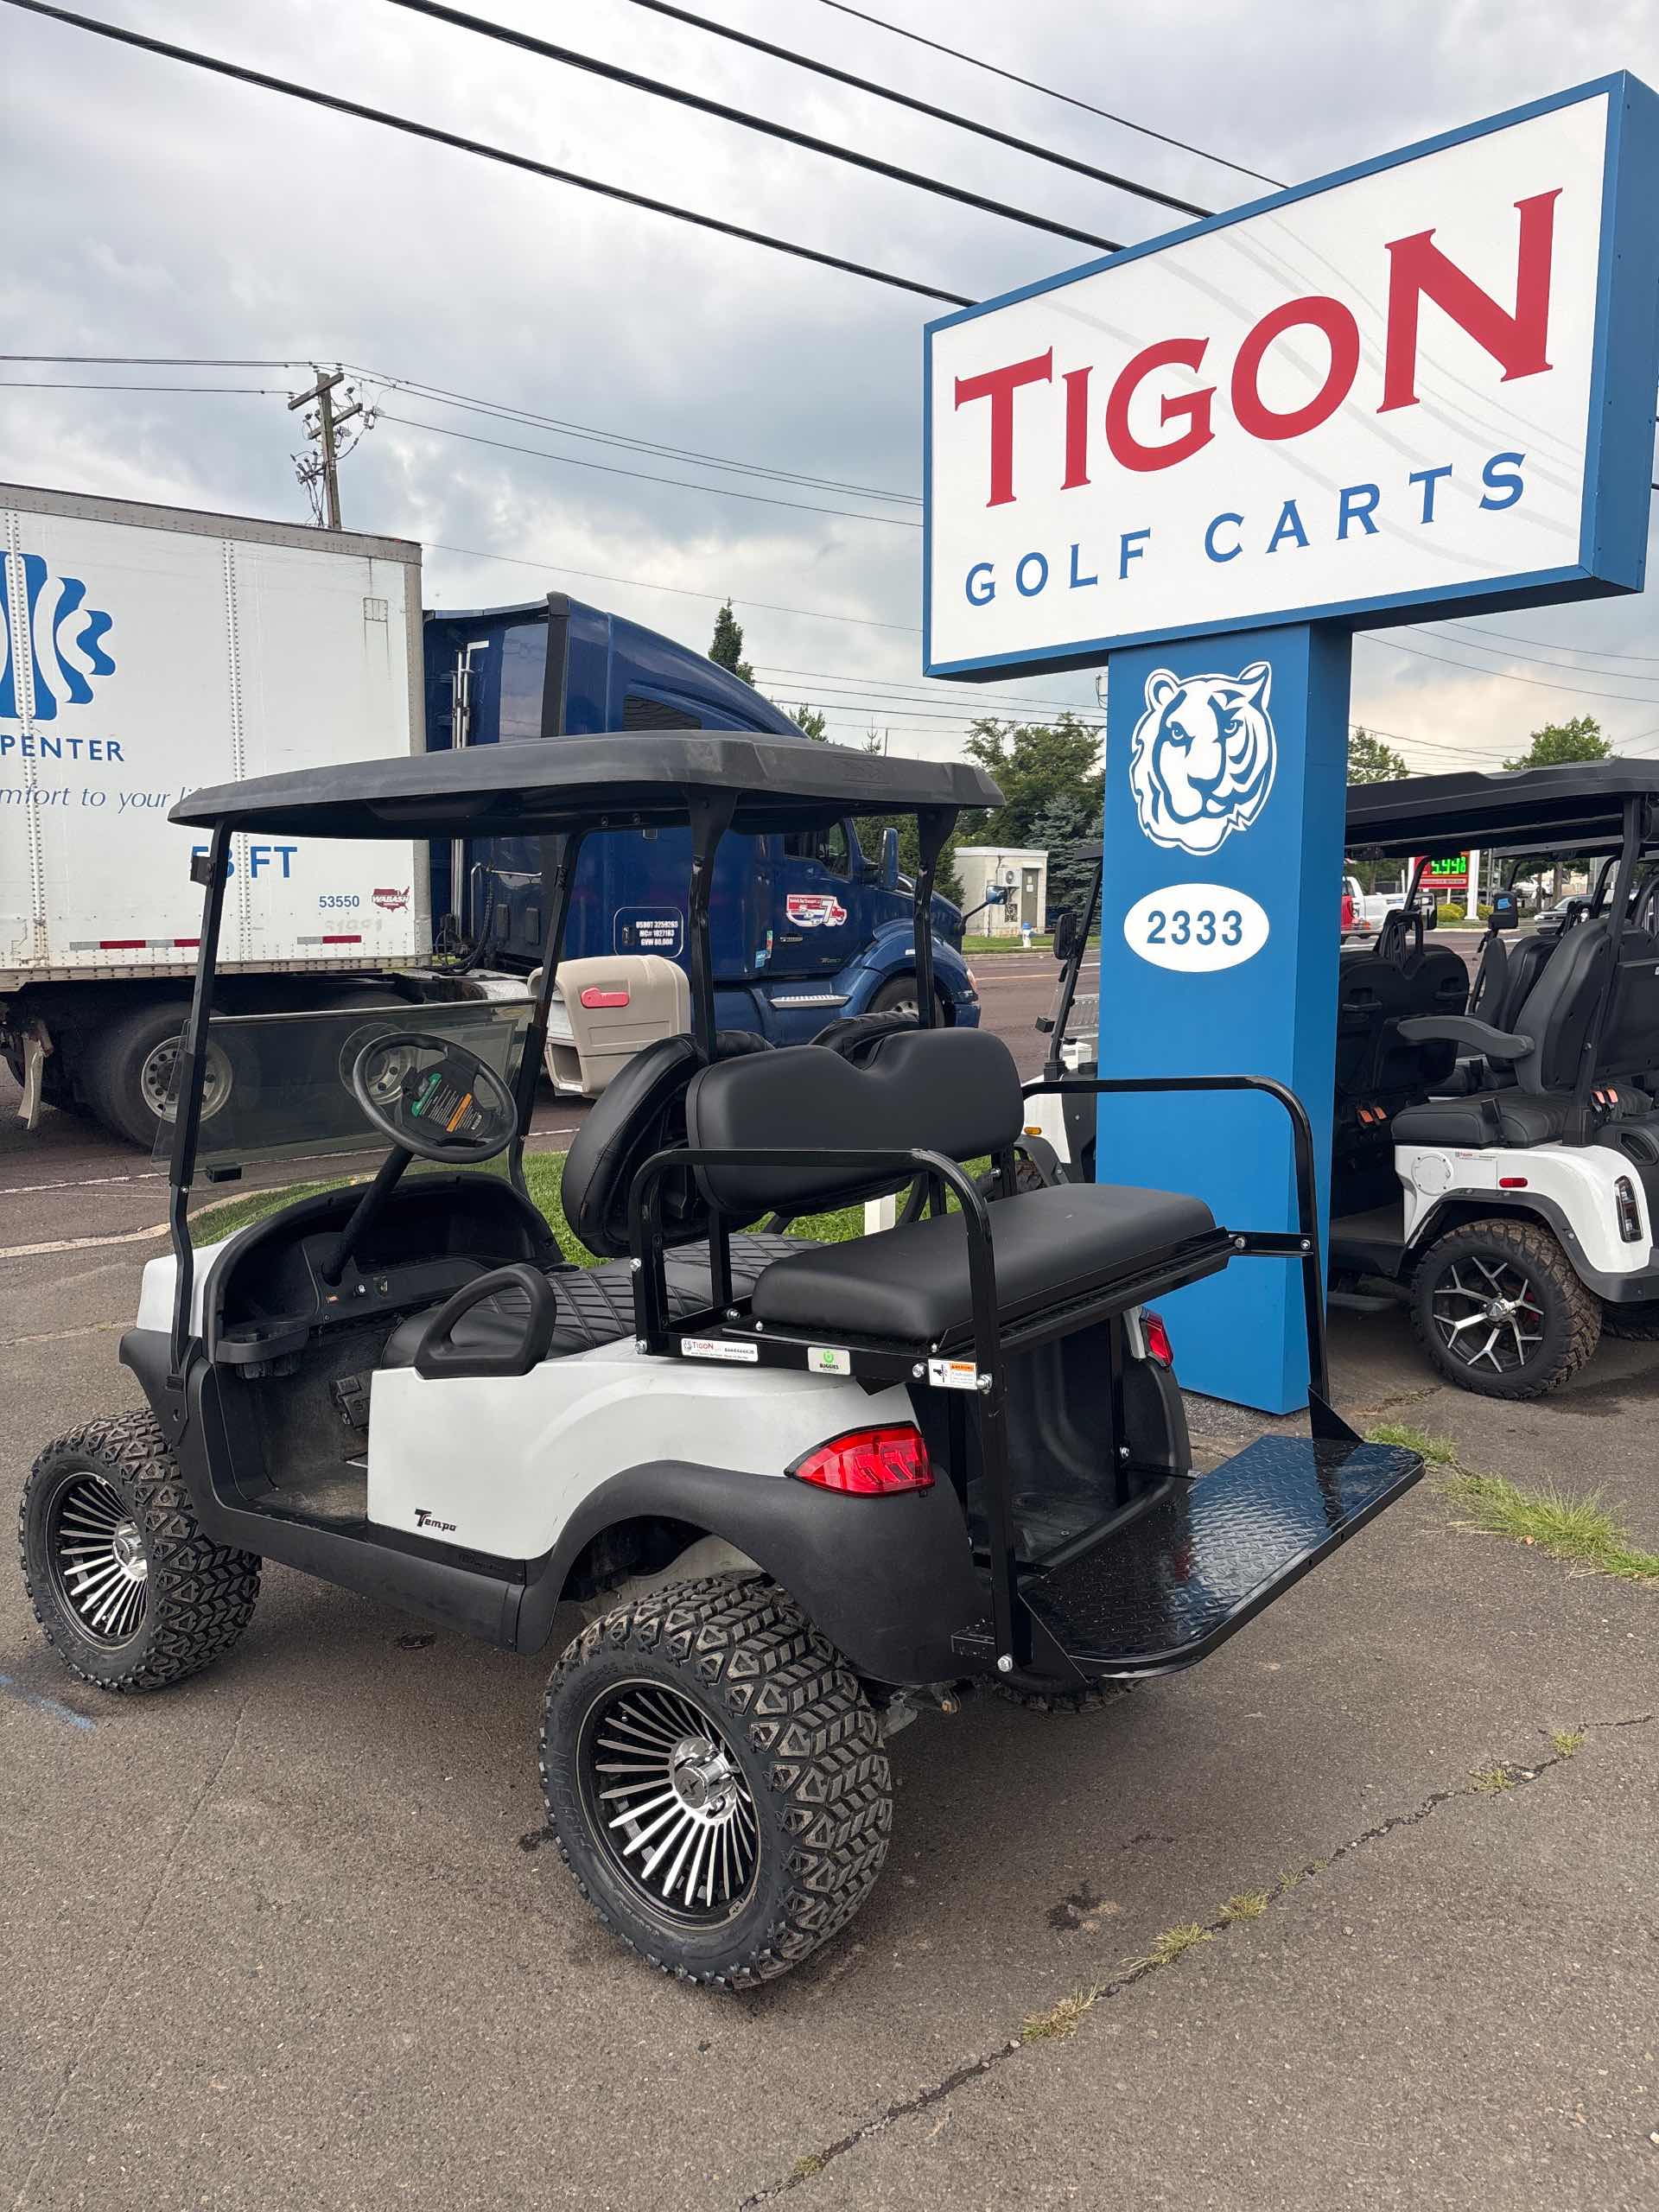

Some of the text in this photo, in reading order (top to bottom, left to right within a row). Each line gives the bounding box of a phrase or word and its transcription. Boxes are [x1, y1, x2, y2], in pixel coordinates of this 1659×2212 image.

[955, 188, 1563, 508] TIGON
[965, 452, 1527, 607] GOLF CARTS
[81, 787, 106, 807] to
[118, 791, 171, 814] your
[250, 846, 298, 879] FT
[318, 895, 360, 908] 53550
[372, 893, 410, 904] WABASH
[822, 899, 835, 924] 7
[1147, 910, 1243, 945] 2333
[692, 1341, 714, 1350] TIGON
[415, 1508, 457, 1532] Tempo
